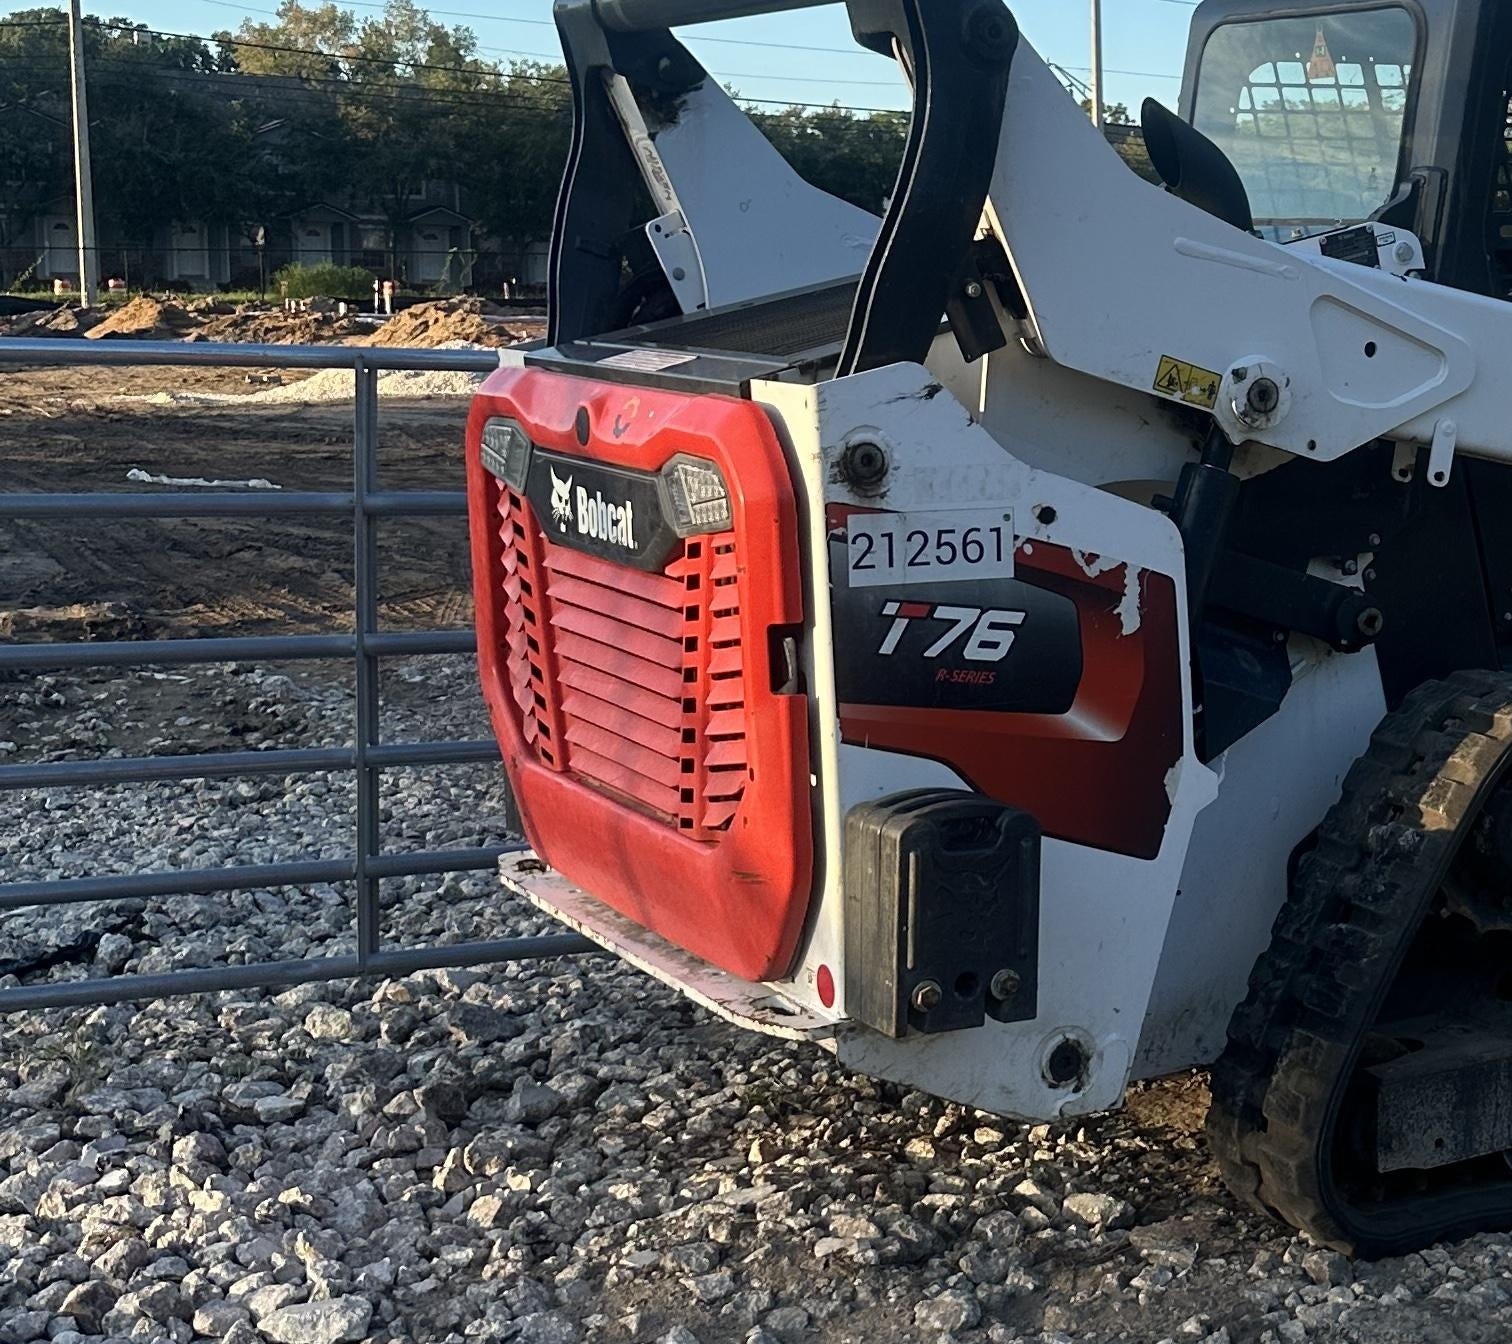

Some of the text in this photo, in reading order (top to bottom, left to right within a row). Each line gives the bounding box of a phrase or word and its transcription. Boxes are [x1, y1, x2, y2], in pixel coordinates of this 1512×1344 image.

[576, 485, 634, 549] Bobcat
[850, 526, 1003, 570] 212561
[878, 601, 1027, 662] T76
[935, 668, 996, 684] R-SERIES
